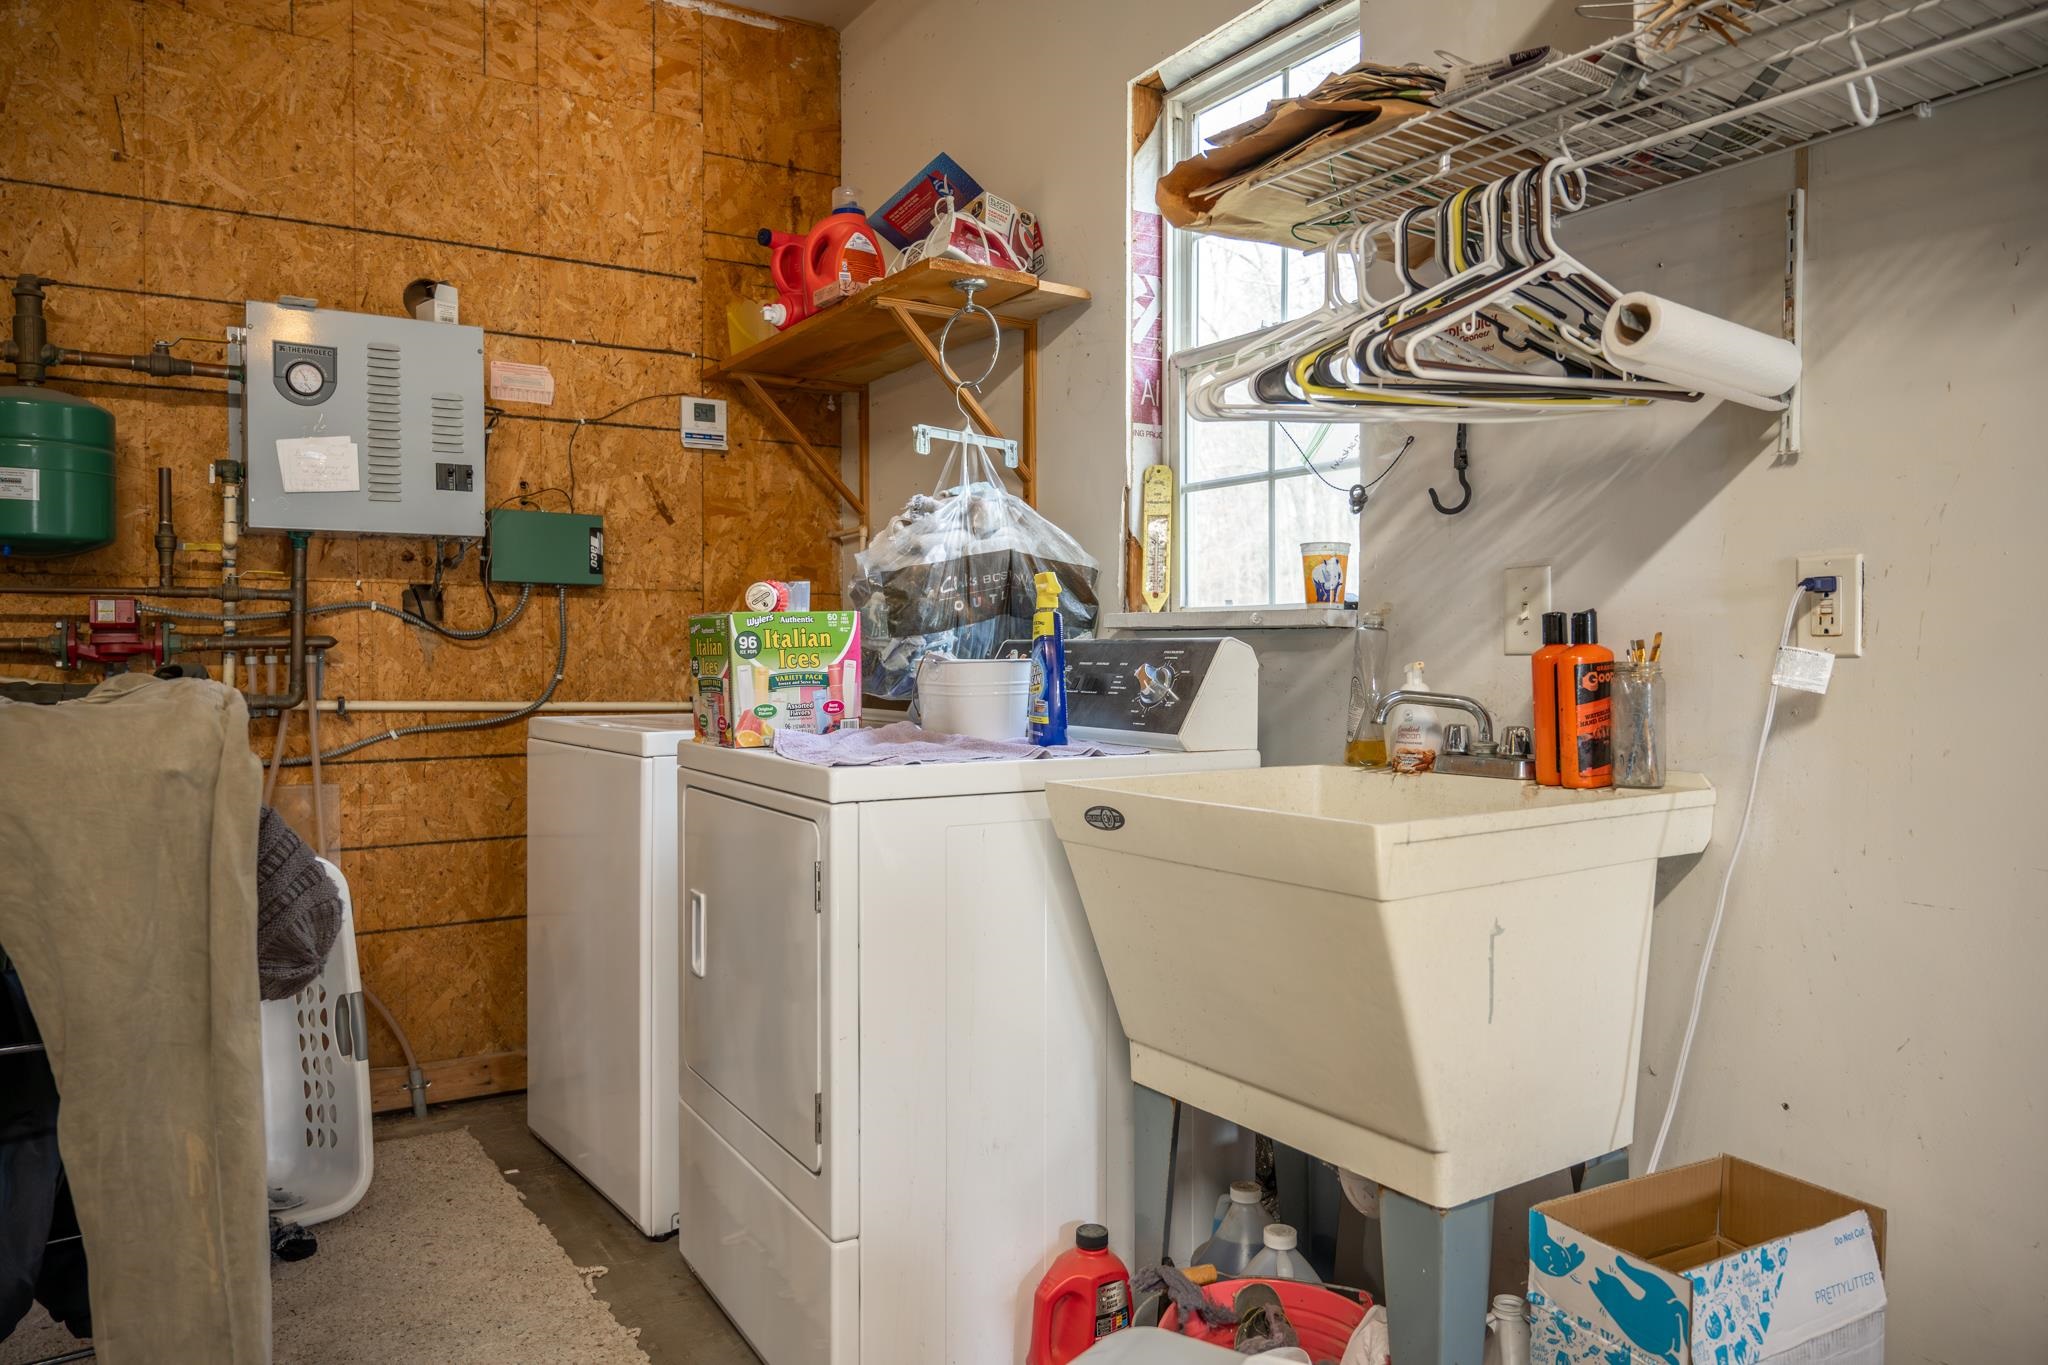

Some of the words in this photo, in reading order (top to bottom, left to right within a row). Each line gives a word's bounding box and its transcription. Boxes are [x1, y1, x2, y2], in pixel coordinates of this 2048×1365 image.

[288, 346, 333, 357] THERMOLEC
[590, 531, 604, 568] Taco
[746, 612, 775, 628] Wyler's
[780, 615, 815, 624] Authentic
[695, 637, 723, 656] Italian
[738, 635, 758, 650] 96
[763, 626, 832, 650] Italian
[701, 656, 719, 675] Ices
[778, 648, 821, 669] Ices
[775, 673, 803, 682] VARIETY
[805, 673, 823, 681] PACK
[786, 702, 815, 710] Assorted
[1580, 717, 1598, 728] HAND
[1833, 1236, 1843, 1246] Do
[1843, 1231, 1854, 1242] Not
[1854, 1227, 1866, 1238] Cut
[1814, 1271, 1876, 1305] PRETTYLITTER
